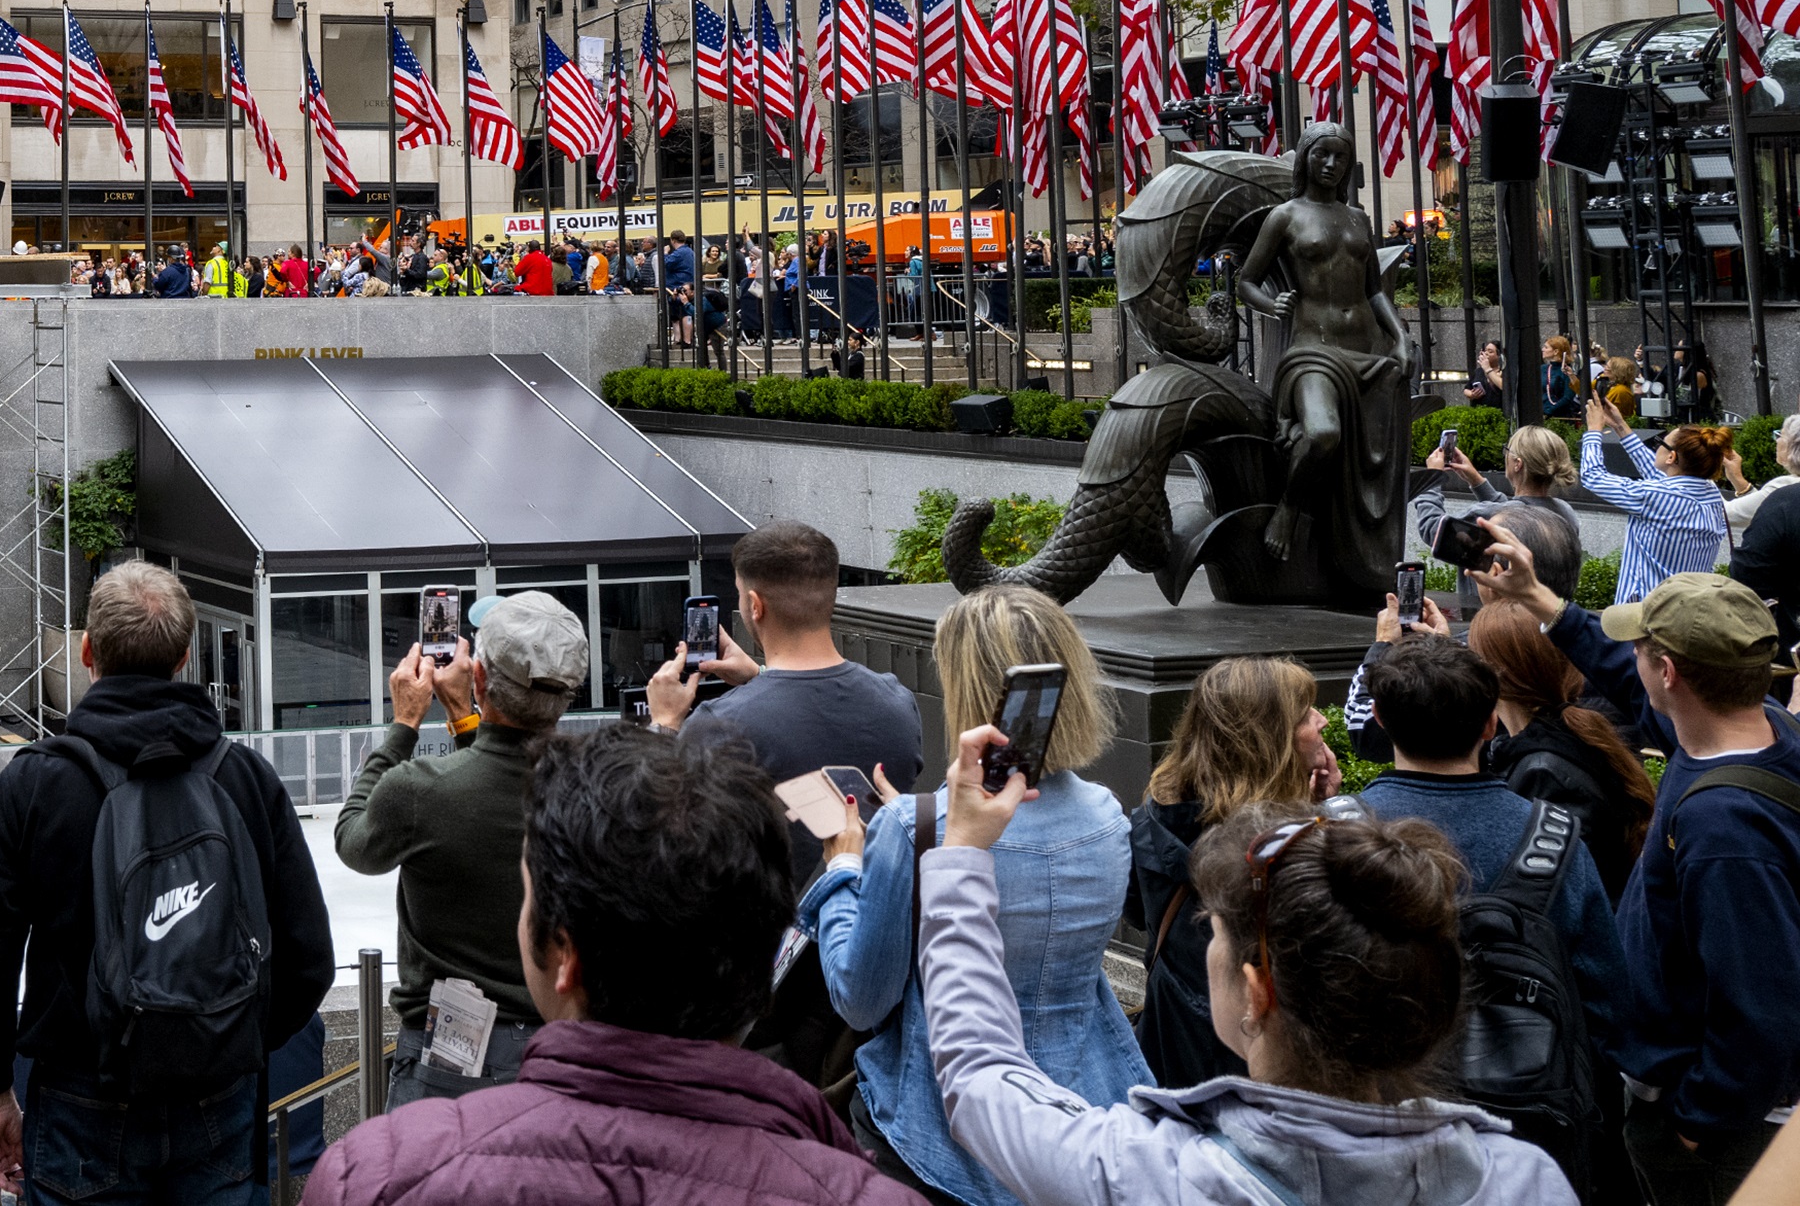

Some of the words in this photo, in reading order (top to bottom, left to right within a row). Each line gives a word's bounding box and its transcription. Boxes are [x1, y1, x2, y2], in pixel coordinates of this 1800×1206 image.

[103, 192, 135, 203] J.CREW
[773, 205, 815, 222] JLG
[825, 202, 878, 219] UTR
[890, 199, 947, 215] BOM
[556, 213, 657, 230] EQUIPMENT
[953, 218, 990, 228] ALE
[153, 880, 199, 922] NIKE
